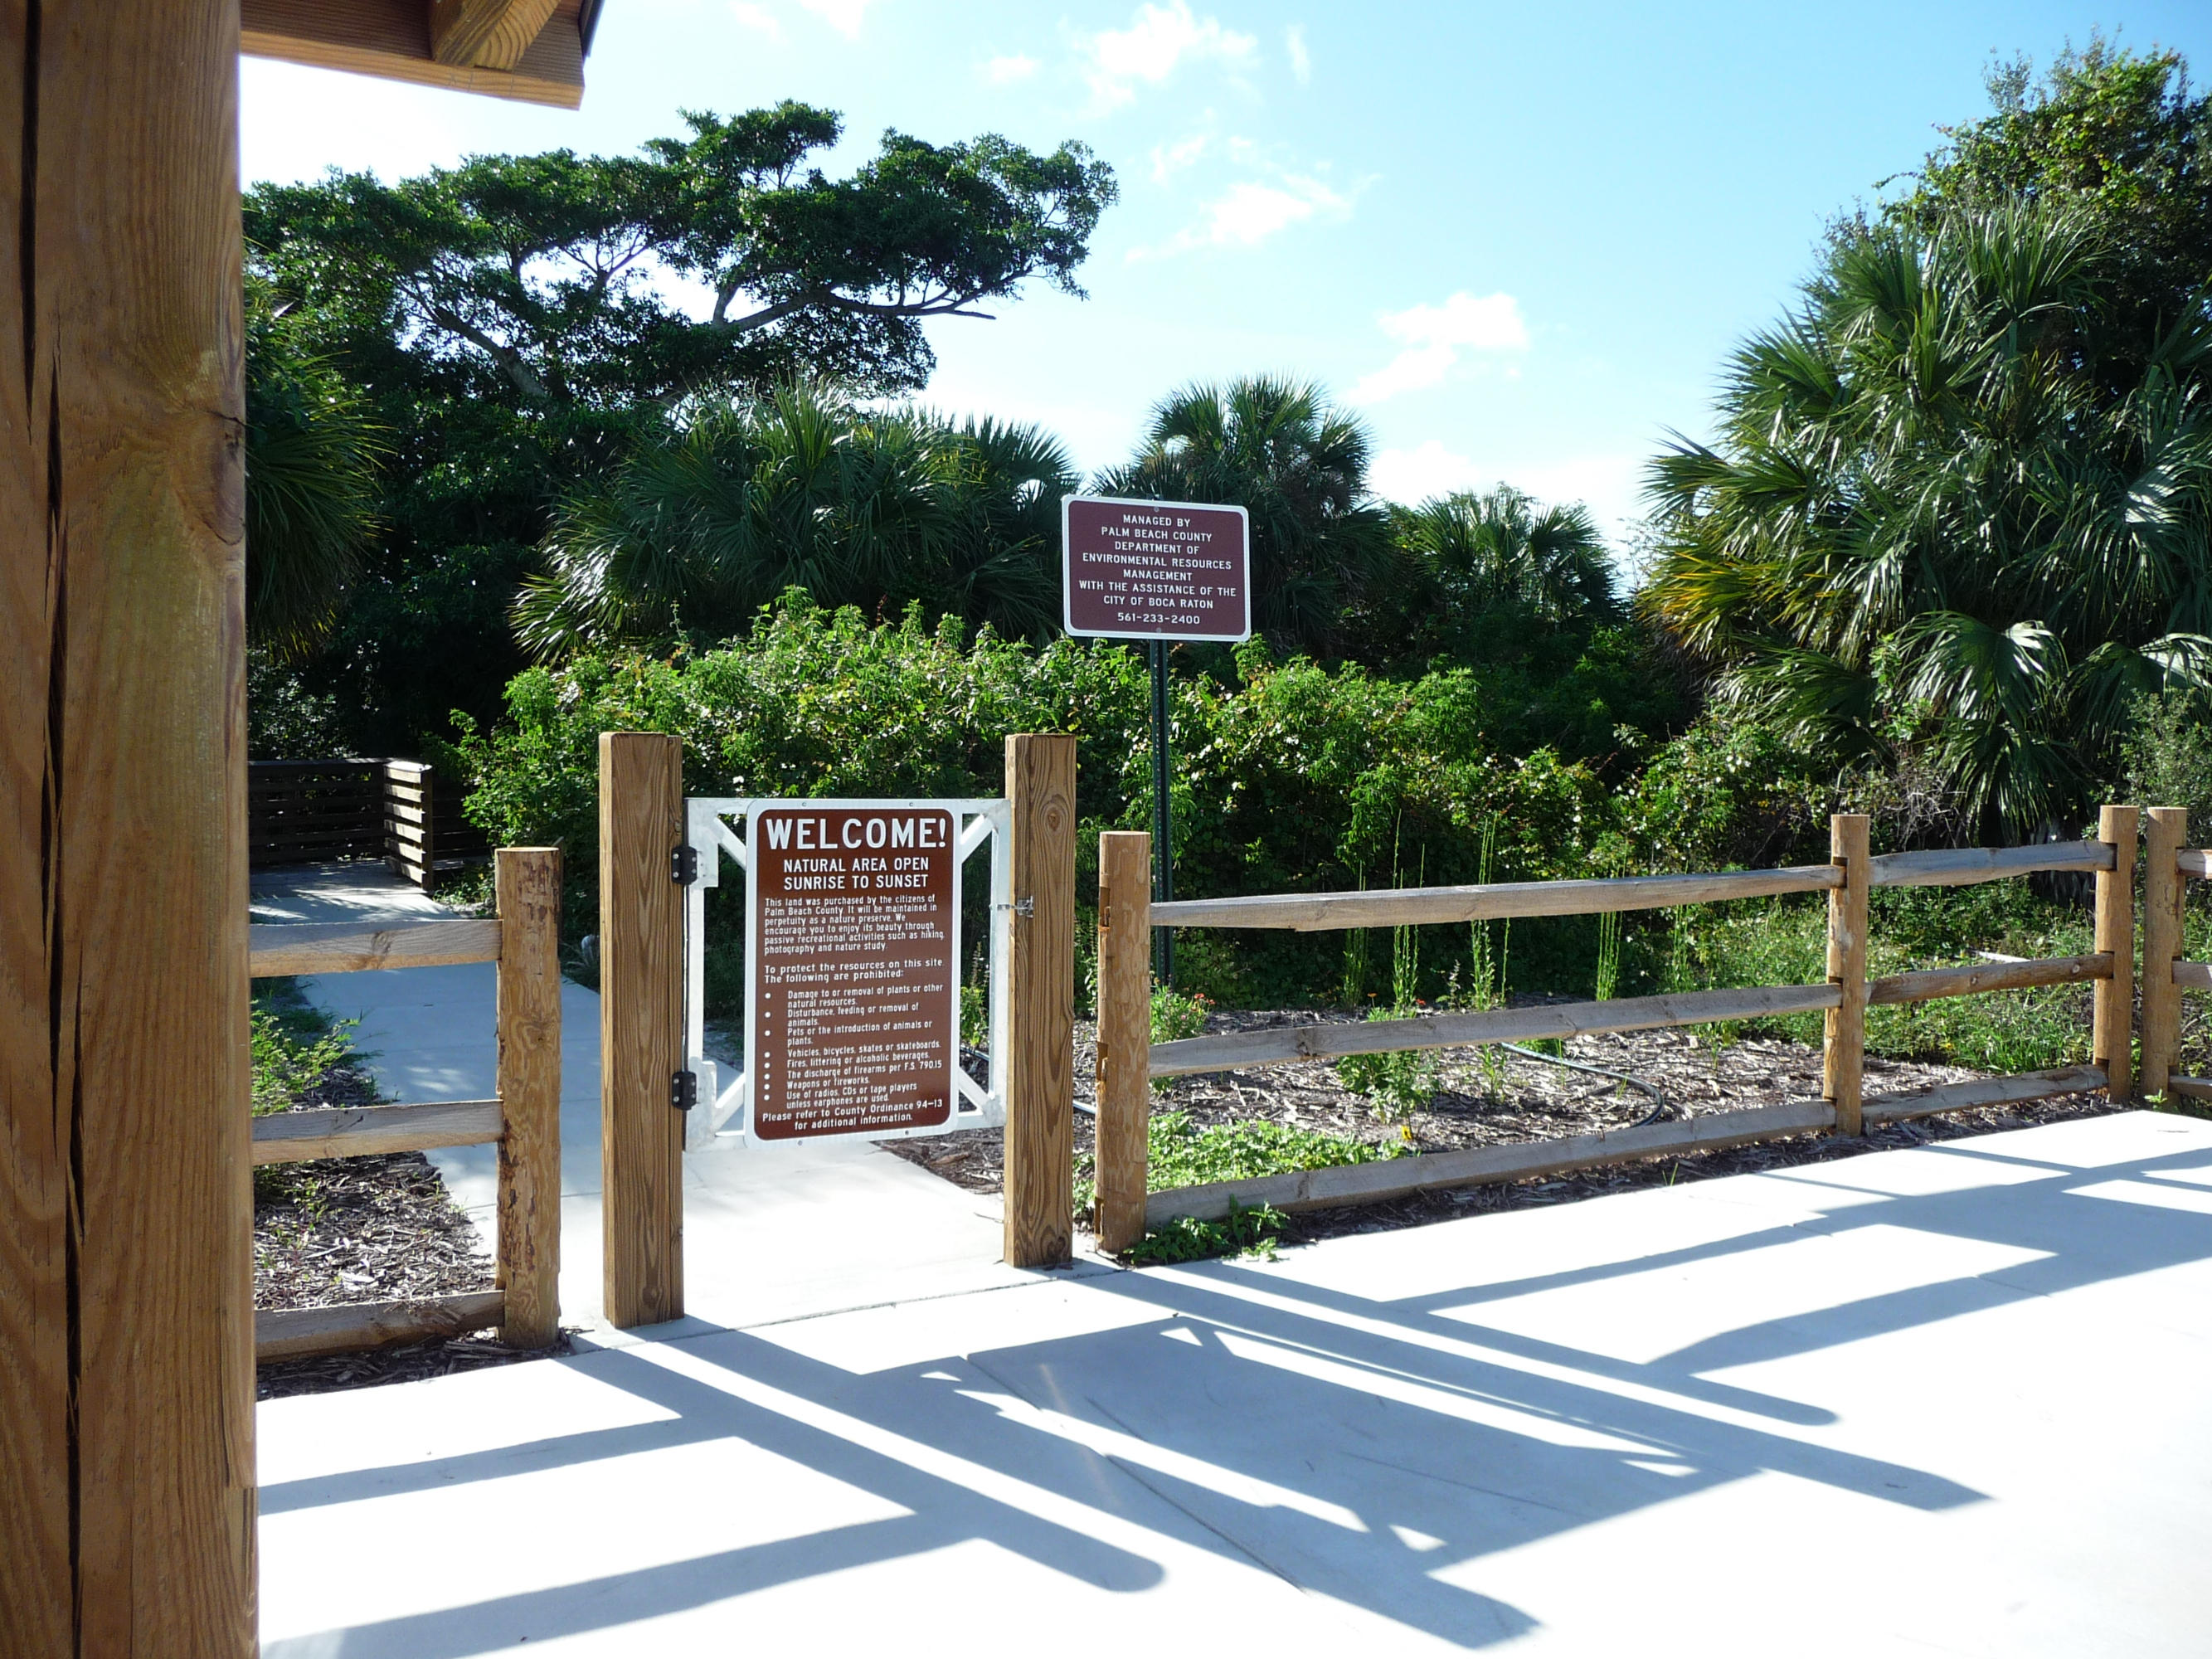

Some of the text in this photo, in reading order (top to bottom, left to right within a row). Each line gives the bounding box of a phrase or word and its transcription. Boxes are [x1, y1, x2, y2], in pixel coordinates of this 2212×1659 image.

[1123, 514, 1190, 527] MANAGED BY
[1101, 527, 1212, 542] PALM BEACH COUNTY
[1115, 542, 1199, 554] DEPARTMENT OF
[1083, 553, 1232, 569] ENVIRONMENTAL RESOURCES
[1123, 569, 1193, 581] MANAGEMENT
[1079, 580, 1236, 596] WITH THE ASSISTANCE OF THE
[1104, 596, 1213, 609] CITY OF BOCA RATON
[1117, 613, 1200, 624] 561-233-2400
[766, 818, 946, 849] WELCOME!
[784, 857, 929, 873] NATURAL AREA OPEN
[784, 874, 928, 890] SUNRISE TO SUNSET
[765, 898, 781, 907] This
[785, 898, 802, 906] land
[824, 897, 863, 907] purchased
[867, 897, 876, 905] by
[896, 894, 925, 903] citizens
[765, 907, 784, 916] Palm
[788, 907, 811, 916] Beach
[886, 904, 927, 912] maintained
[765, 917, 805, 927] perpetuity
[829, 915, 855, 923] nature
[765, 922, 934, 937] encourage you to enjoy its beauty through
[765, 935, 794, 946] passive
[798, 933, 845, 942] recreational
[849, 932, 885, 941] activities
[888, 932, 906, 940] such
[764, 944, 814, 956] photography
[819, 943, 832, 951] and
[835, 941, 861, 951] nature
[765, 966, 775, 974] To
[780, 965, 815, 975] protect
[840, 962, 884, 971] resources
[904, 959, 921, 967] this
[765, 975, 781, 984] The
[786, 973, 829, 983] following
[788, 990, 819, 1000] Damage
[843, 987, 873, 995] removal
[878, 986, 884, 995] of
[887, 985, 910, 995] plants
[788, 1000, 816, 1008] natural
[838, 1007, 864, 1015] feeding
[879, 1004, 908, 1012] removal
[912, 1002, 919, 1010] of
[787, 1028, 804, 1037] Pets
[834, 1024, 880, 1033] introduction
[893, 1021, 921, 1029] animals
[859, 1044, 882, 1053] skates
[810, 1058, 841, 1067] littering
[856, 1054, 889, 1063] alcoholic
[787, 1070, 801, 1078] The
[805, 1068, 840, 1079] discharge
[844, 1067, 851, 1075] of
[854, 1064, 886, 1073] firearms
[889, 1064, 901, 1074] per
[787, 1080, 819, 1091] Weapons
[787, 1091, 800, 1099] Use
[804, 1089, 811, 1098] of
[843, 1087, 856, 1096] CDs
[871, 1085, 886, 1095] tape
[890, 1082, 917, 1092] players
[787, 1100, 810, 1109] unless
[814, 1097, 853, 1108] earphones
[763, 1112, 792, 1121] Please
[796, 1110, 818, 1119] refer
[835, 1106, 866, 1117] County
[871, 1103, 913, 1113] Ordinance
[795, 1121, 807, 1131] for
[812, 1117, 856, 1129] additional
